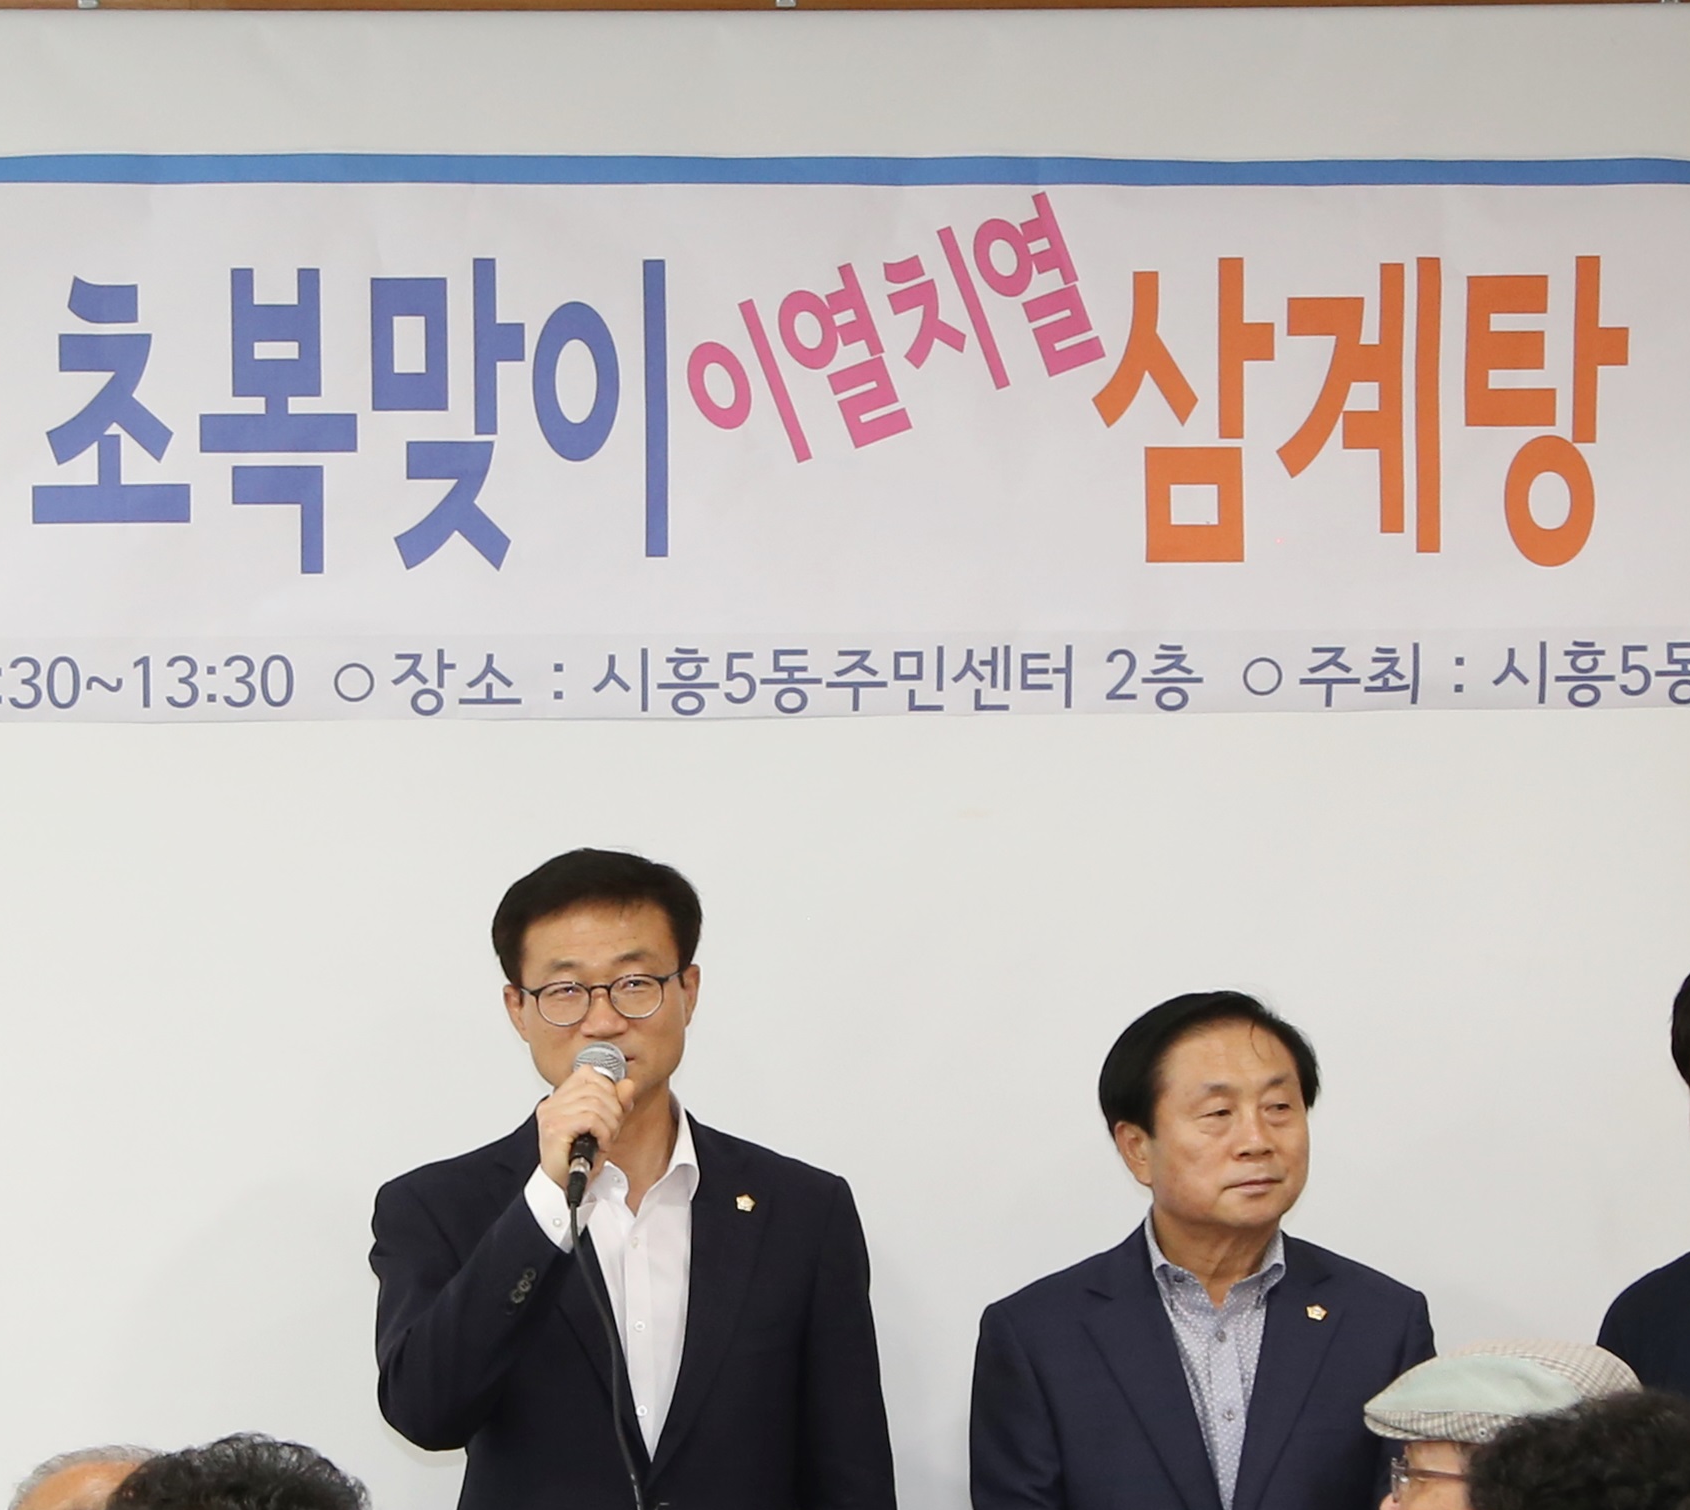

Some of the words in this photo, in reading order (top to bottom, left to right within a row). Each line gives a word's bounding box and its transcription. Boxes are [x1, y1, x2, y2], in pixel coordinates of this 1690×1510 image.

[31, 257, 669, 575] 초복맞이
[686, 191, 1107, 464] 이열치열
[1091, 255, 1631, 568] 삼계탕
[391, 648, 523, 717] 장소
[592, 644, 1074, 717] 시흥5동주민센터
[1105, 643, 1205, 712] 2층
[1298, 642, 1421, 708] 주최
